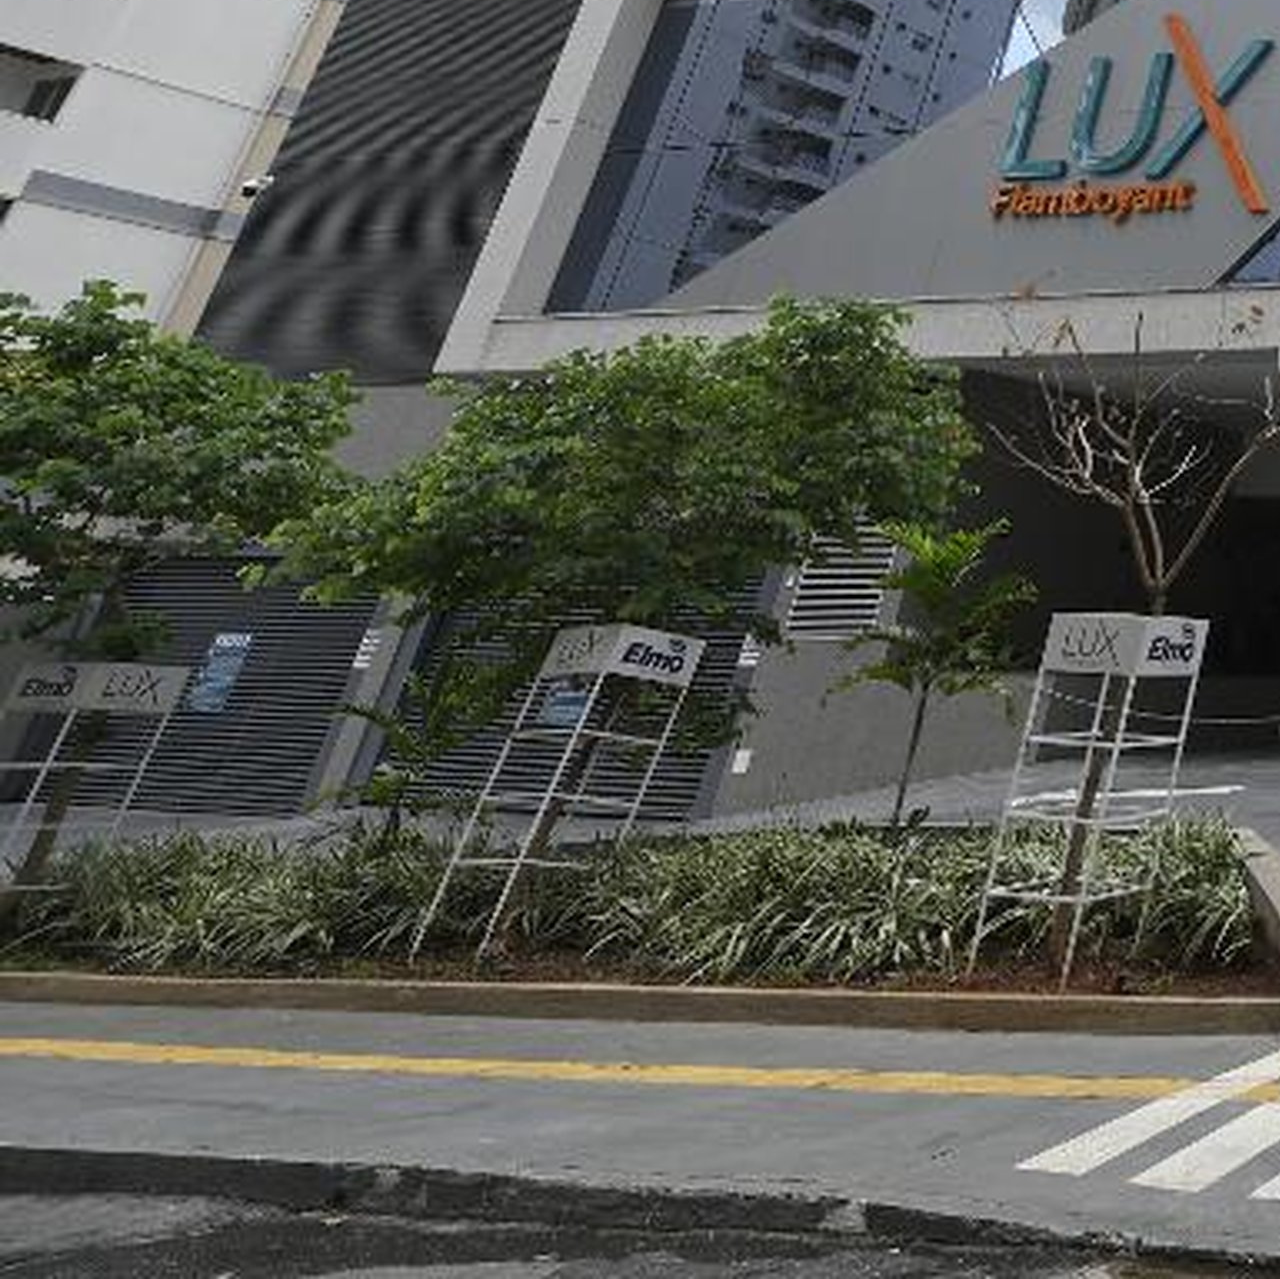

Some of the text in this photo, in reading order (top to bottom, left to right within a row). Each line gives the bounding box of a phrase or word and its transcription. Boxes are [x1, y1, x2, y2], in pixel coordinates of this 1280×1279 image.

[1000, 12, 1276, 215] LUX
[991, 180, 1199, 225] Flamboyant
[621, 641, 684, 672] Elmo
[1061, 619, 1120, 667] LUX
[1146, 635, 1195, 662] Elmo
